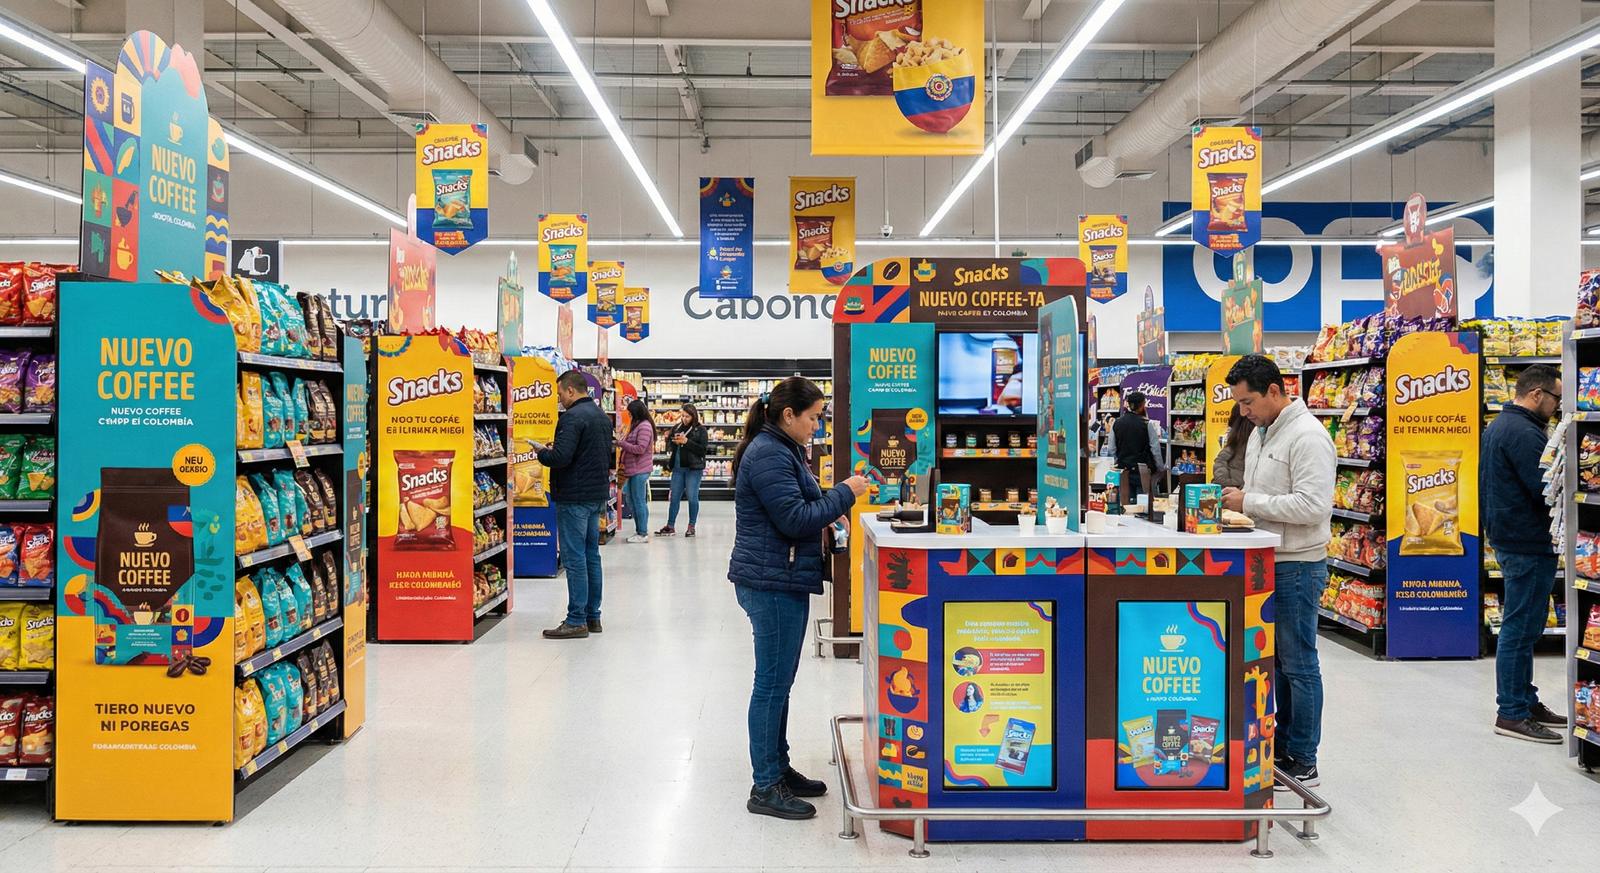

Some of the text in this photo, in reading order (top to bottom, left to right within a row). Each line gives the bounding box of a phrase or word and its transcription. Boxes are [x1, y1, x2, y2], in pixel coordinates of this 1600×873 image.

[422, 138, 482, 165] Snacks
[1198, 140, 1256, 169] Snacks
[152, 143, 196, 184] NUEVO
[149, 175, 196, 214] COFFEE
[437, 180, 468, 196] Snacks
[794, 183, 850, 211] Snacks
[1212, 182, 1243, 198] Snacks
[542, 223, 584, 243] Snacks
[799, 225, 830, 239] Snacks
[1083, 224, 1124, 243] Snacks
[590, 267, 622, 282] Snacks
[953, 263, 1009, 287] Snacks
[919, 290, 1046, 307] NUEVO COFFEE-TA
[101, 337, 193, 366] NUEVO
[869, 348, 916, 363] NUEVO
[868, 364, 918, 379] COFFEE
[97, 371, 195, 400] COFFEE
[388, 368, 463, 406] Snacks
[511, 380, 552, 403] nacks
[1395, 364, 1471, 405] Snacks
[111, 407, 182, 416] NUEVO COFFEE
[391, 416, 413, 424] NOO
[415, 416, 427, 424] TU
[184, 456, 203, 465] NEU
[880, 449, 906, 457] NUEVO
[880, 457, 906, 466] COFFEE
[401, 467, 448, 491] Snacks
[1407, 468, 1456, 494] Snacks
[119, 552, 171, 568] NUEVO
[118, 569, 171, 586] COFFEE
[1143, 656, 1201, 674] NUEVO
[1142, 676, 1201, 694] COFFEE
[94, 703, 196, 715] TIERO NUEVO
[101, 720, 190, 731] NI POREGAS
